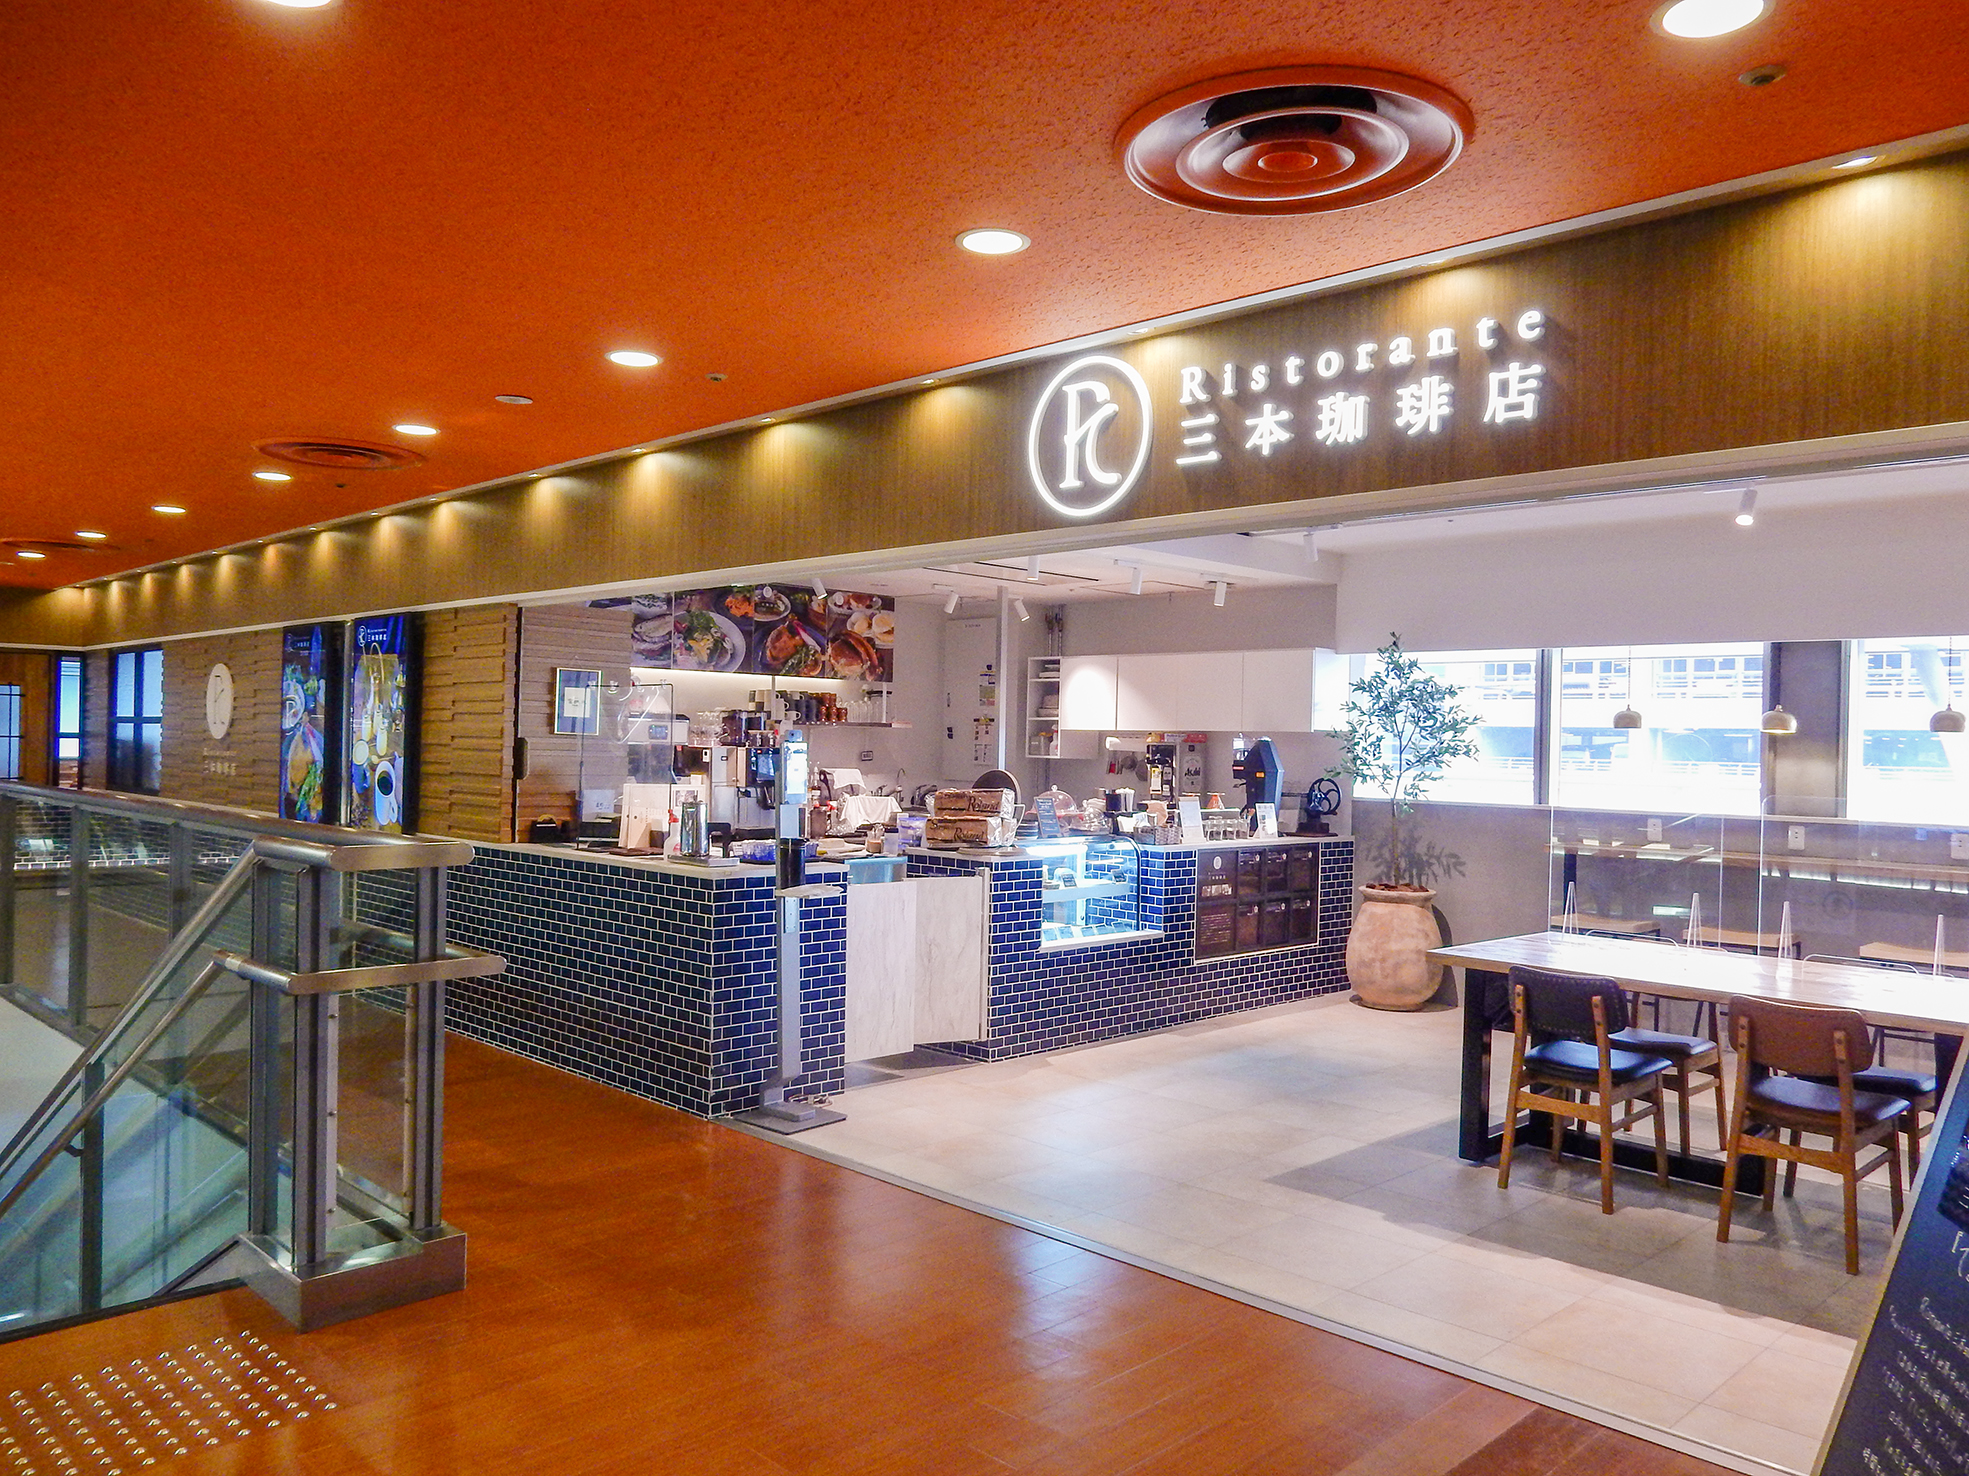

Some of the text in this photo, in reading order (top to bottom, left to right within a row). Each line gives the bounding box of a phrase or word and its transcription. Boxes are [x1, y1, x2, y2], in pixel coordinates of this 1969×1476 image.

[1179, 309, 1546, 405] Ristorante
[1176, 362, 1546, 466] 三本珈琲店
